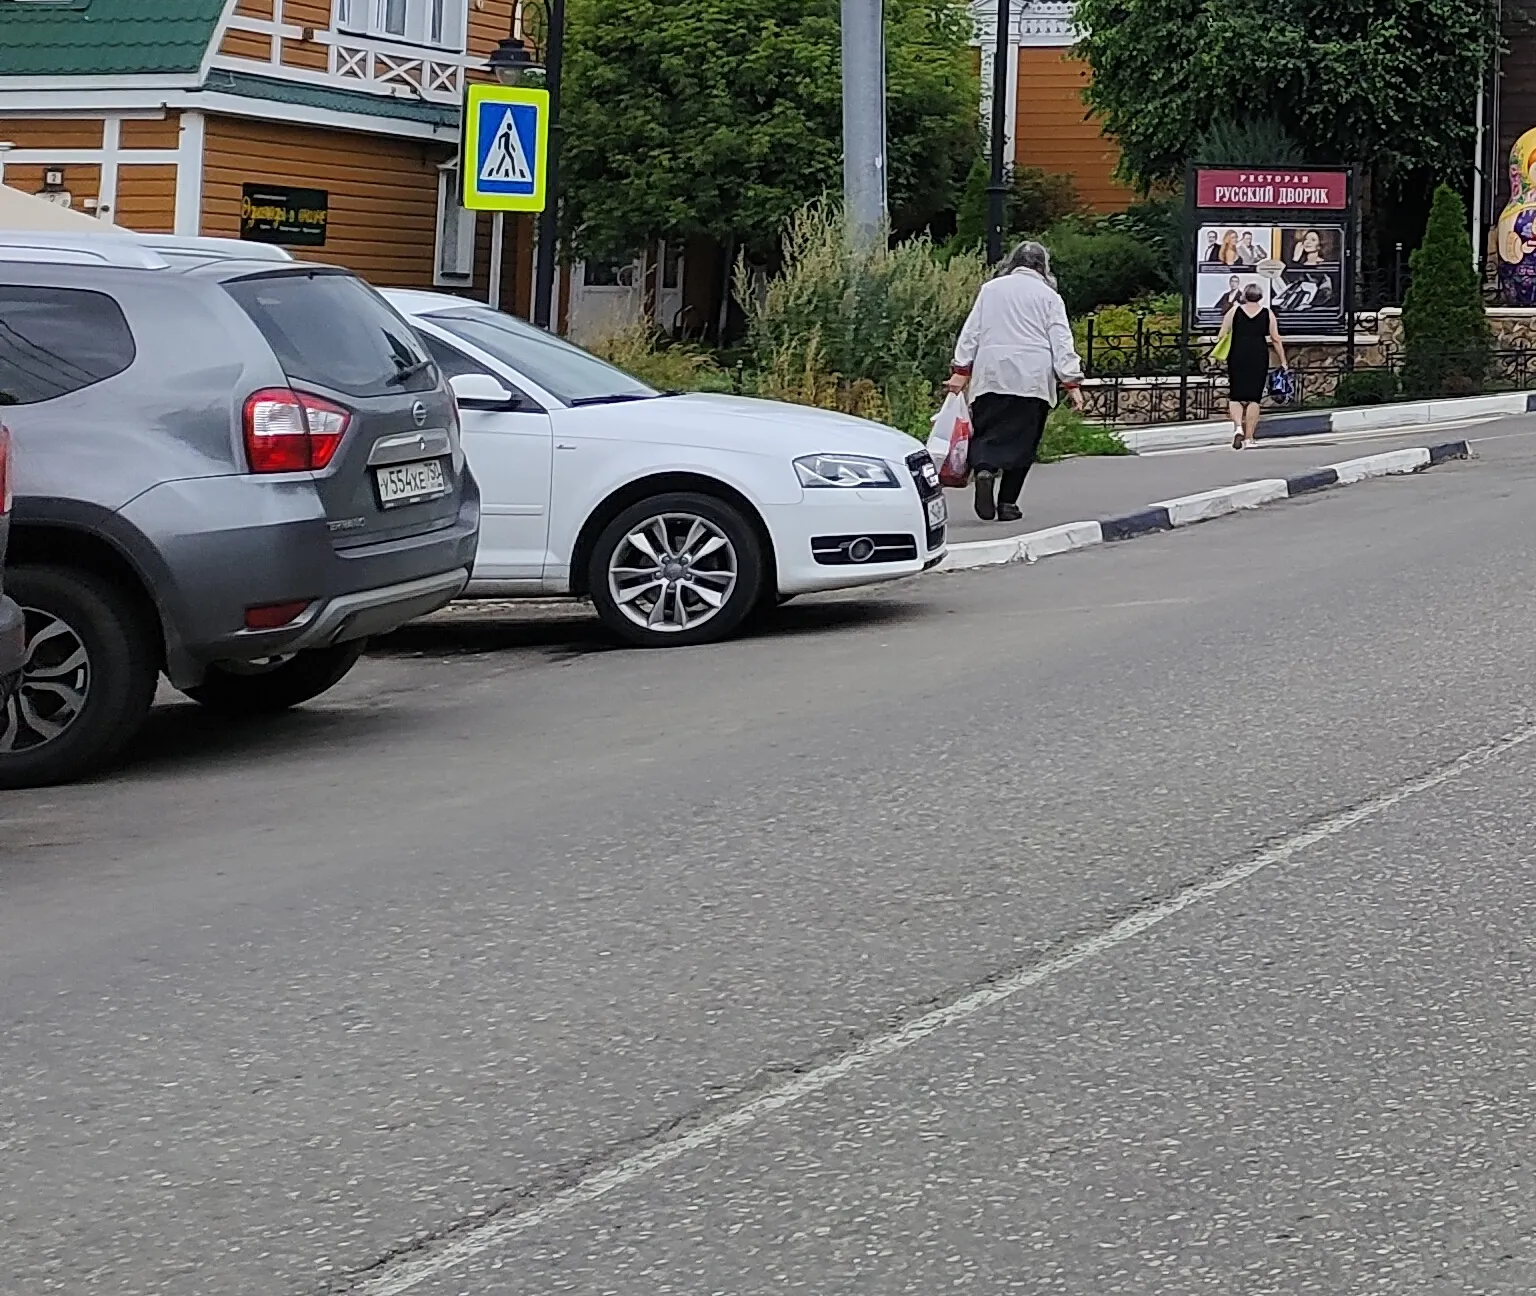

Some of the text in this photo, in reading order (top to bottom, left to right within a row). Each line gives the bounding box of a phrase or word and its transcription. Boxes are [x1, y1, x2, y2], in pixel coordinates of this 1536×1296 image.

[1238, 174, 1309, 183] РЕСТОРАН
[1215, 185, 1329, 205] РУССКИЙ ДВОРИК
[382, 467, 427, 497] У554ХЕ
